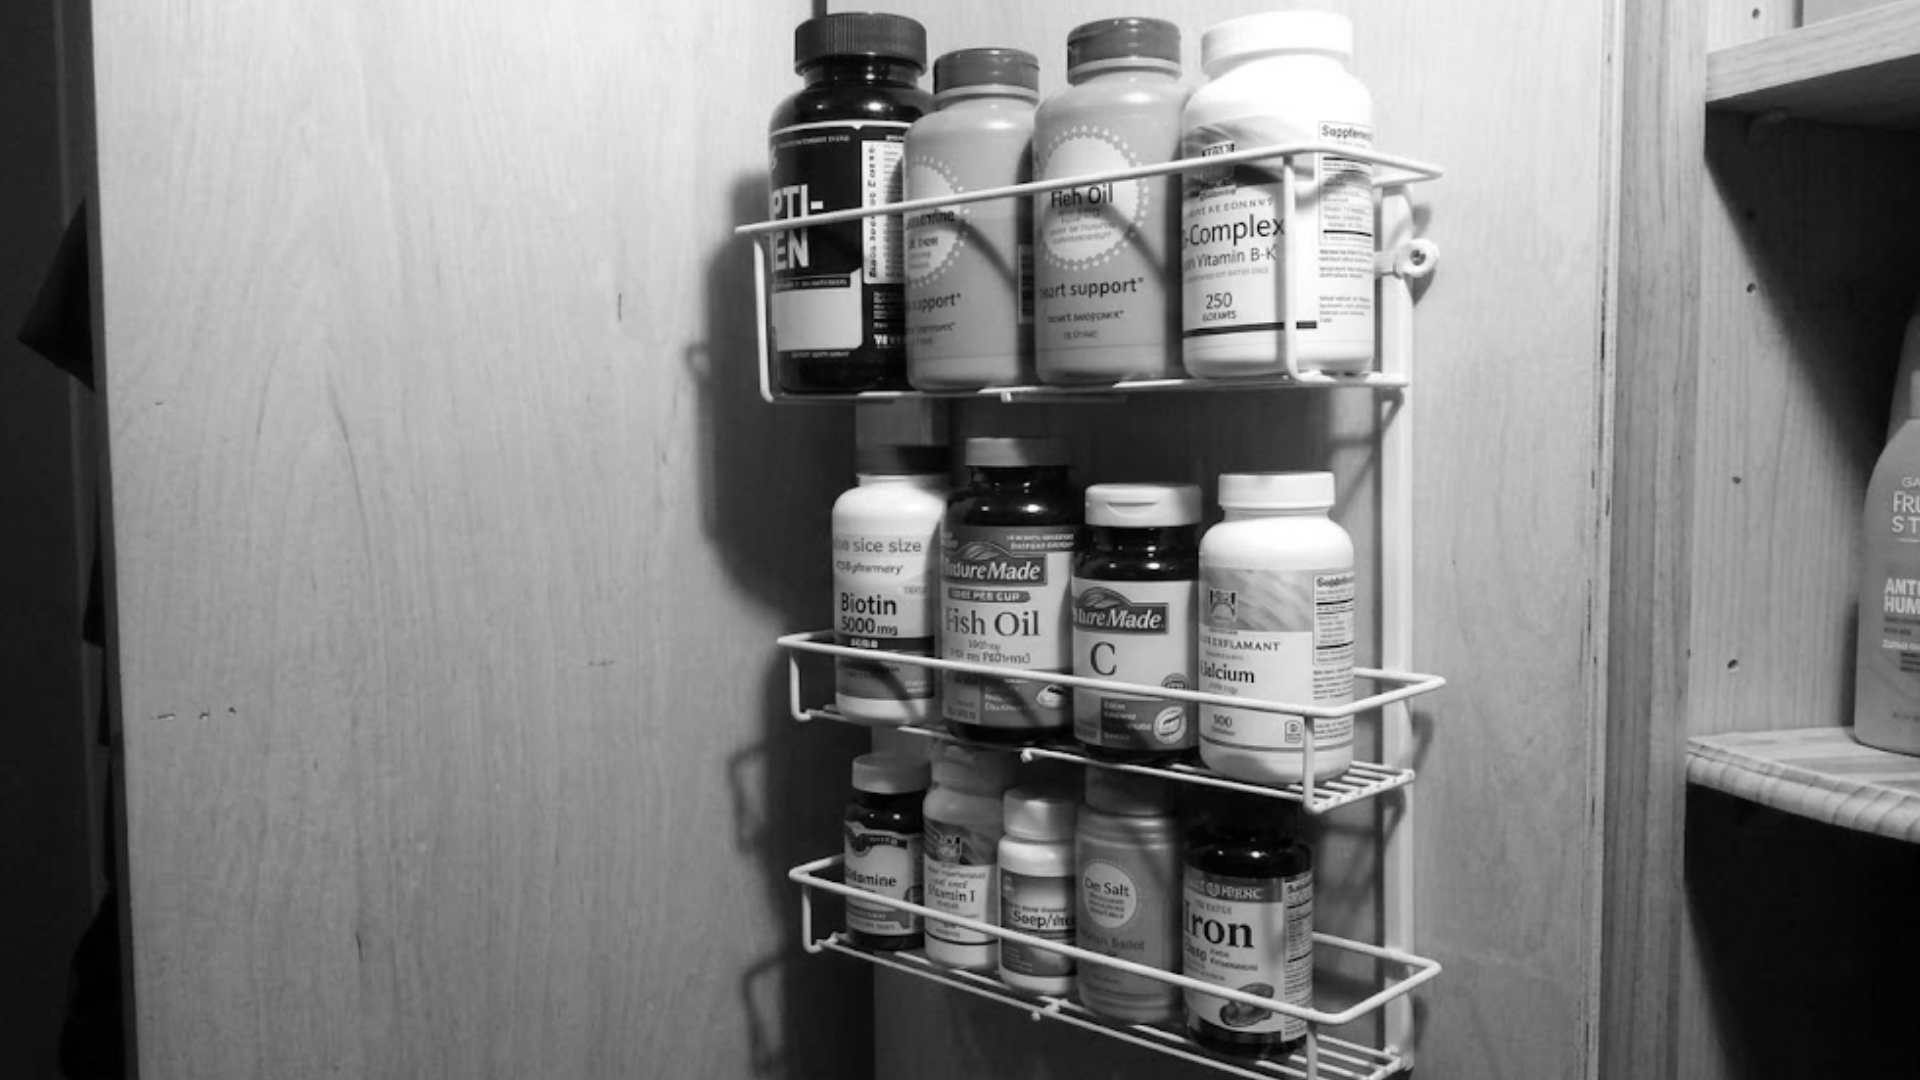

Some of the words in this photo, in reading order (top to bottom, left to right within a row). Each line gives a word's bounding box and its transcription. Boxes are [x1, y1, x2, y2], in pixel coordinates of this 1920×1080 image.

[1088, 183, 1113, 204] Oil
[770, 227, 809, 273] EN
[1196, 250, 1245, 268] Vitamin
[1206, 292, 1233, 310] 250
[841, 592, 897, 615] Biotin
[841, 615, 875, 635] 5000
[945, 606, 986, 636] Fish
[994, 609, 1041, 637] Oil
[1090, 641, 1118, 676] C
[1104, 882, 1130, 898] Salt
[1184, 901, 1255, 949] Iron
